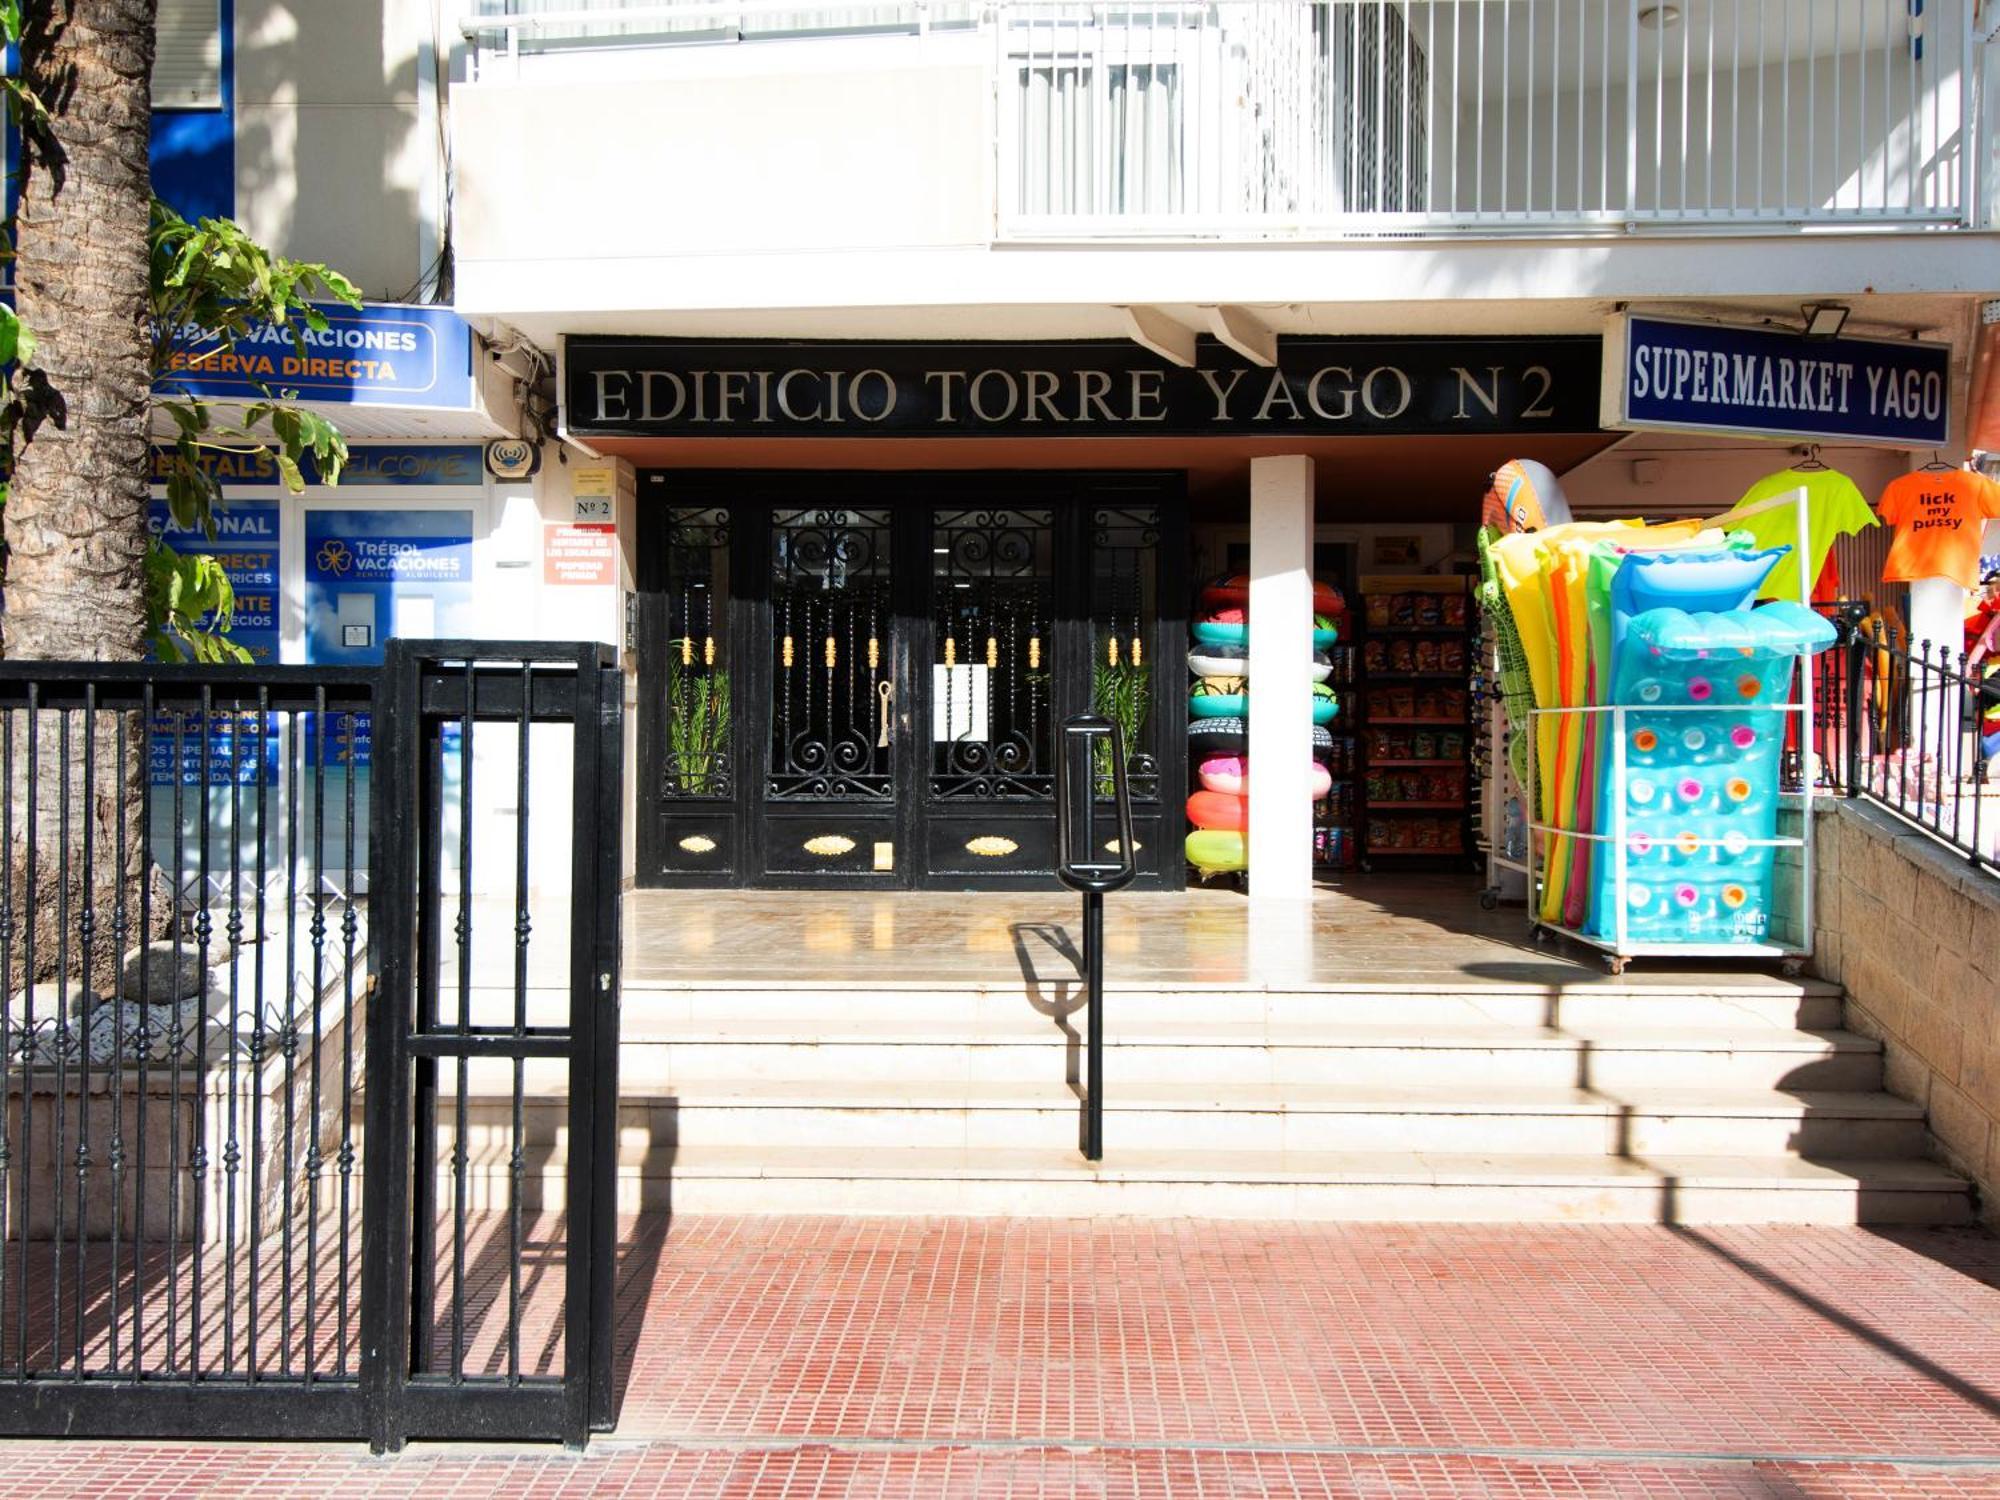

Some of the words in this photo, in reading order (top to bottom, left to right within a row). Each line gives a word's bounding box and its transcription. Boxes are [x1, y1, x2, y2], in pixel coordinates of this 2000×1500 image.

[244, 322, 417, 351] VACACIONES
[167, 352, 274, 375] ESERVA
[283, 356, 397, 381] DIRECTA
[1633, 344, 1853, 414] SUPERMARKET
[1866, 365, 1942, 421] YAGO
[590, 367, 897, 424] EDIFICIO
[924, 368, 1168, 423] TORRE
[1200, 366, 1412, 421] YAGO
[1450, 366, 1504, 419] N
[1520, 366, 1554, 418] 2
[152, 454, 273, 478] ENTALS
[1920, 493, 1955, 505] lick
[602, 503, 609, 514] 2
[1927, 507, 1951, 517] my
[1913, 518, 1963, 532] pussy
[355, 541, 421, 556] TRÉBOL
[355, 558, 460, 570] VACACIONES
